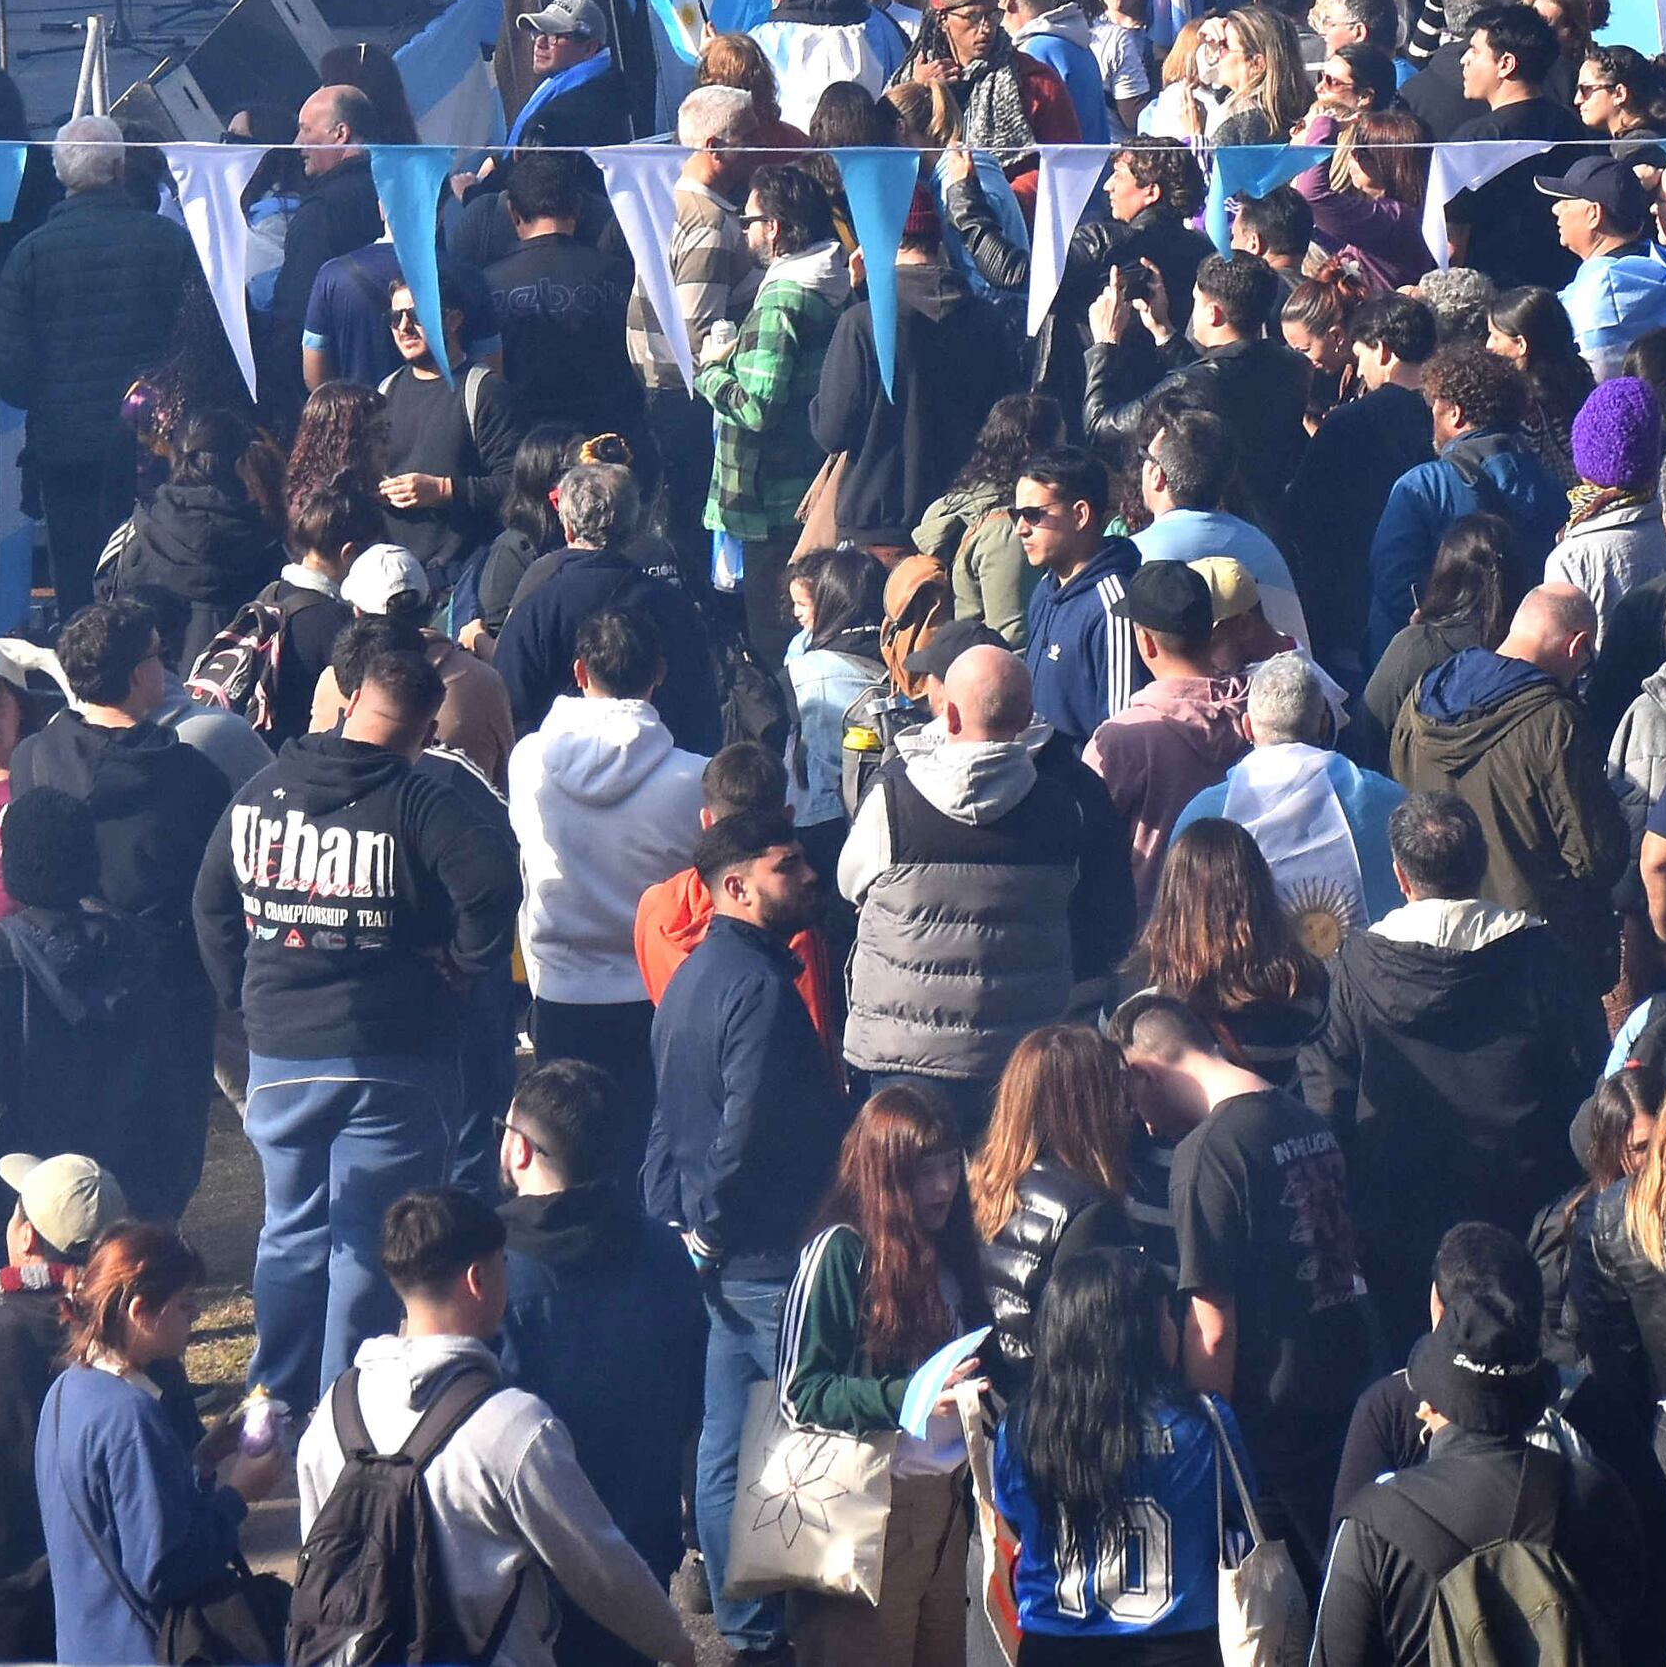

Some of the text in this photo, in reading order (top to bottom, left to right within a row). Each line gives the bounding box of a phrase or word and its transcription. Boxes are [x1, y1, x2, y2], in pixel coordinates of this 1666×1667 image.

[231, 804, 395, 899] Urban
[264, 900, 349, 927] CHAMPIONSHIP
[1054, 1496, 1174, 1624] 10
